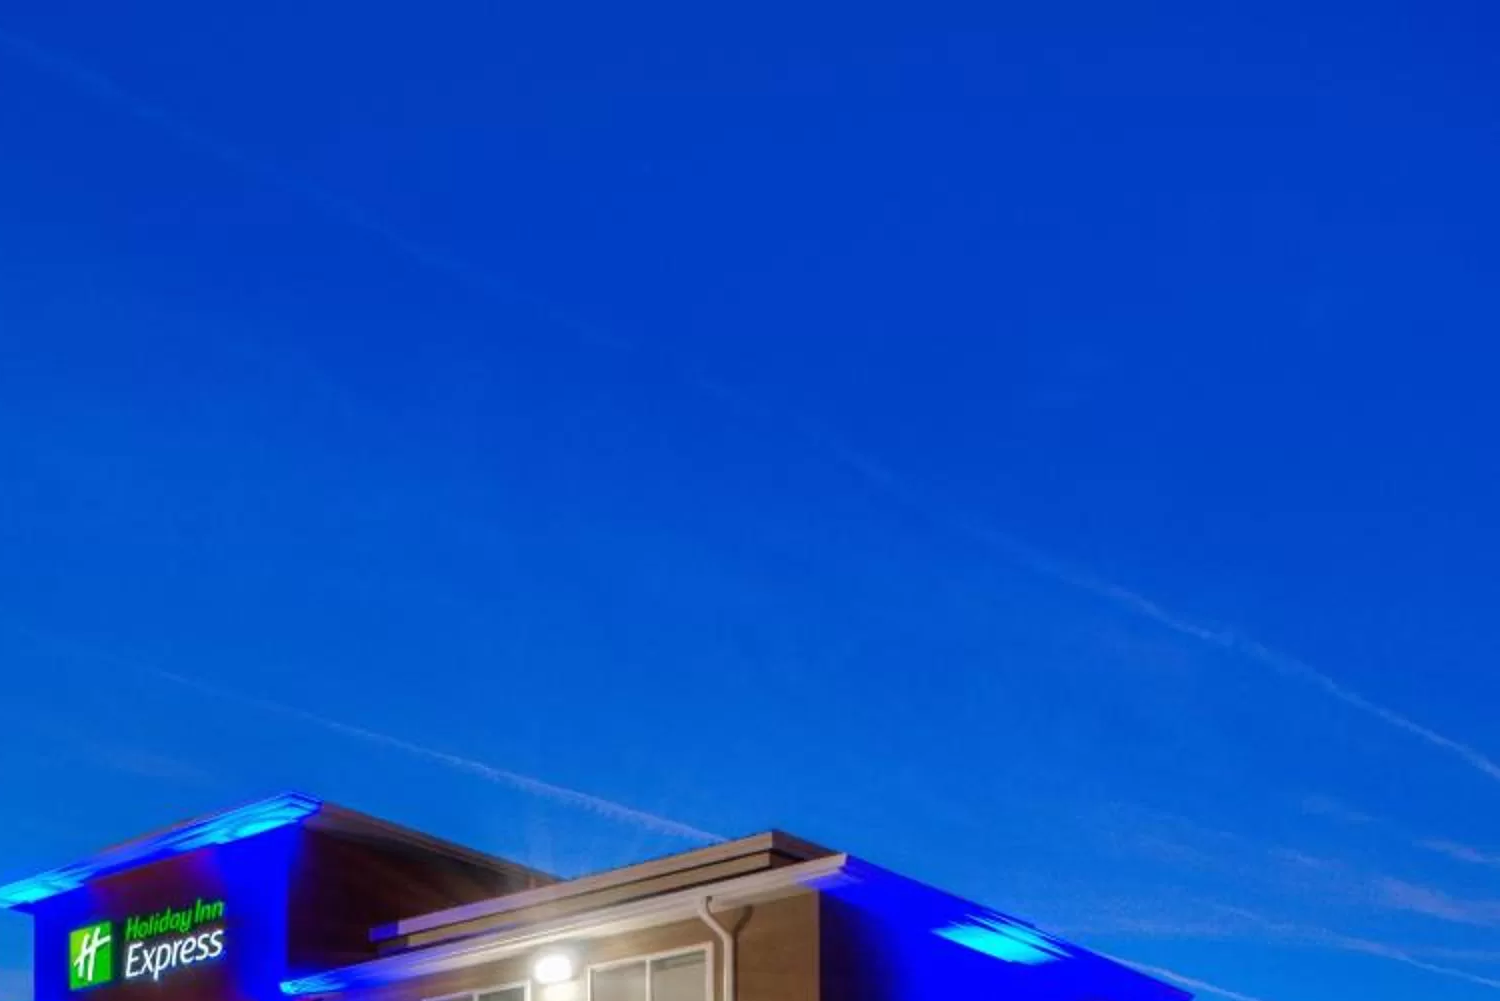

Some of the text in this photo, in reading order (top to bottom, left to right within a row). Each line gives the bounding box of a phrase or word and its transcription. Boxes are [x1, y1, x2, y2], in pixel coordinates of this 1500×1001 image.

[125, 898, 224, 940] Holiday Inn
[125, 929, 224, 980] Express
